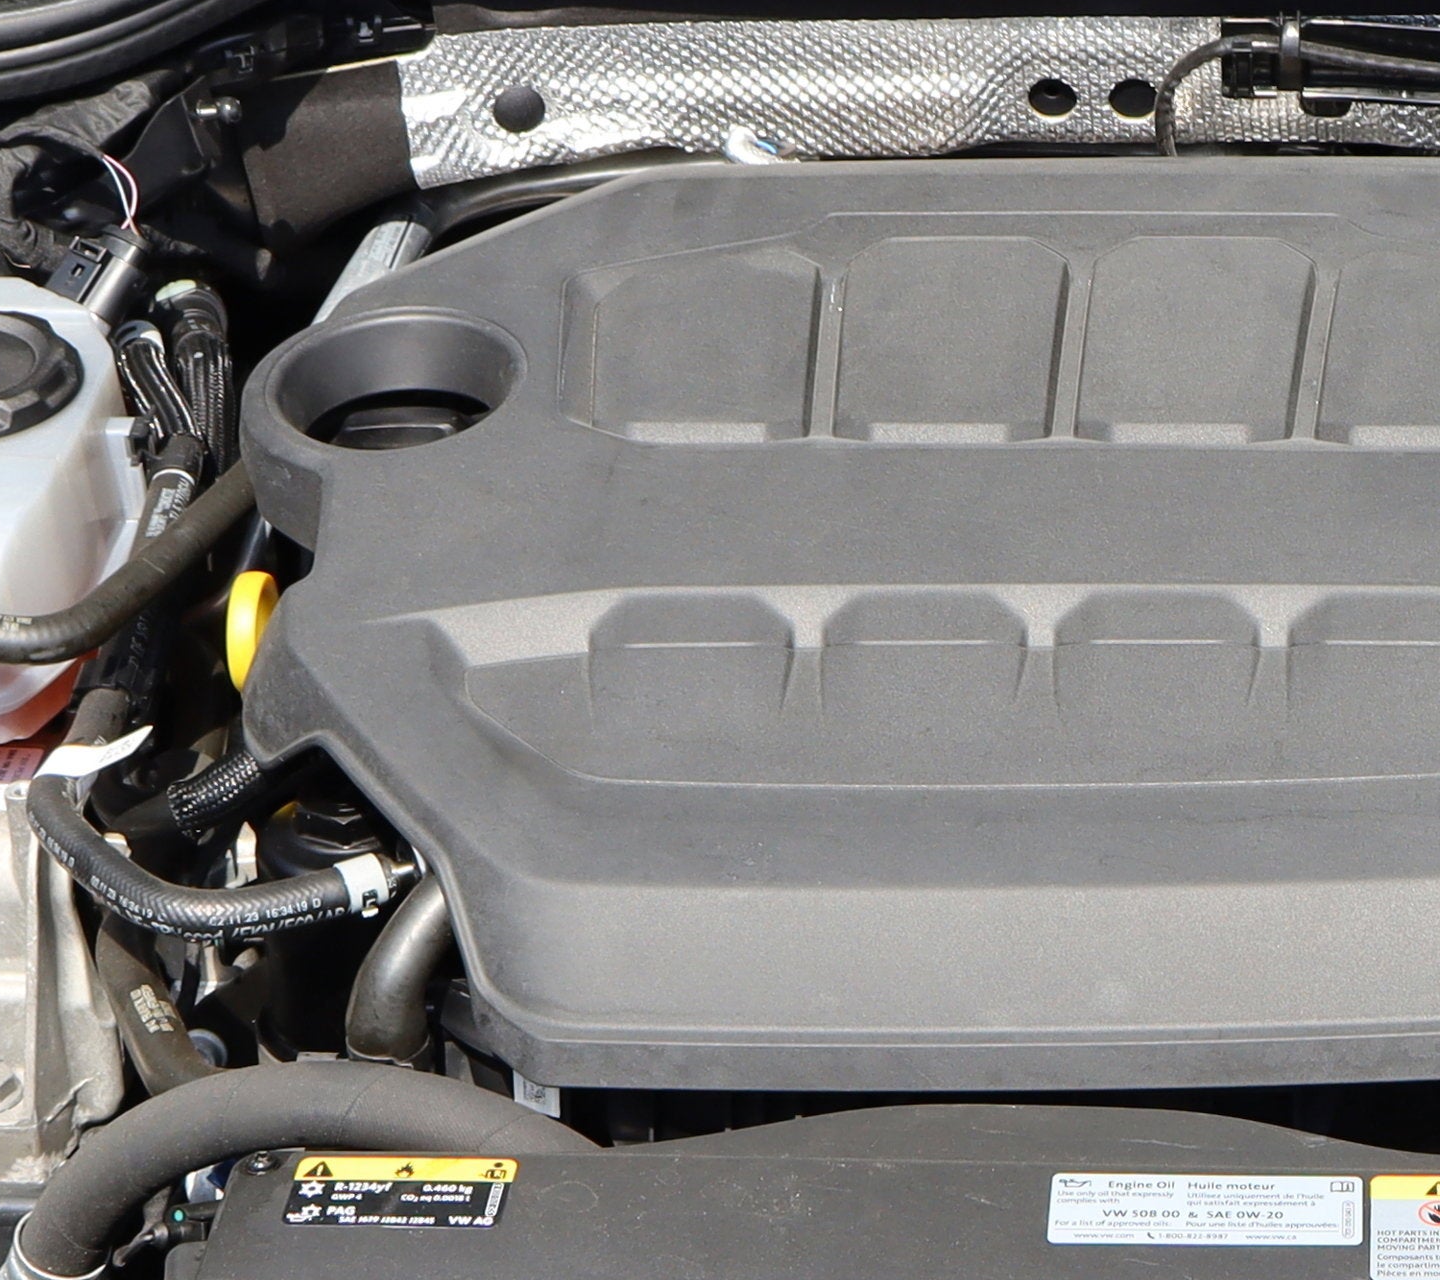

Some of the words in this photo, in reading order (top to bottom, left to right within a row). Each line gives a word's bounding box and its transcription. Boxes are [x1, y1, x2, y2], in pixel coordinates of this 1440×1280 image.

[334, 1182, 393, 1194] R-1234yf
[422, 1184, 457, 1193] 0.460
[458, 1184, 473, 1194] kg
[1108, 1181, 1153, 1190] Engine
[1187, 1182, 1222, 1190] Huile
[326, 1206, 356, 1215] PAG
[1132, 1210, 1157, 1218] 508
[1161, 1210, 1180, 1218] 00
[1236, 1211, 1284, 1219] 0W-20
[448, 1216, 472, 1225] VW
[473, 1216, 494, 1225] AG
